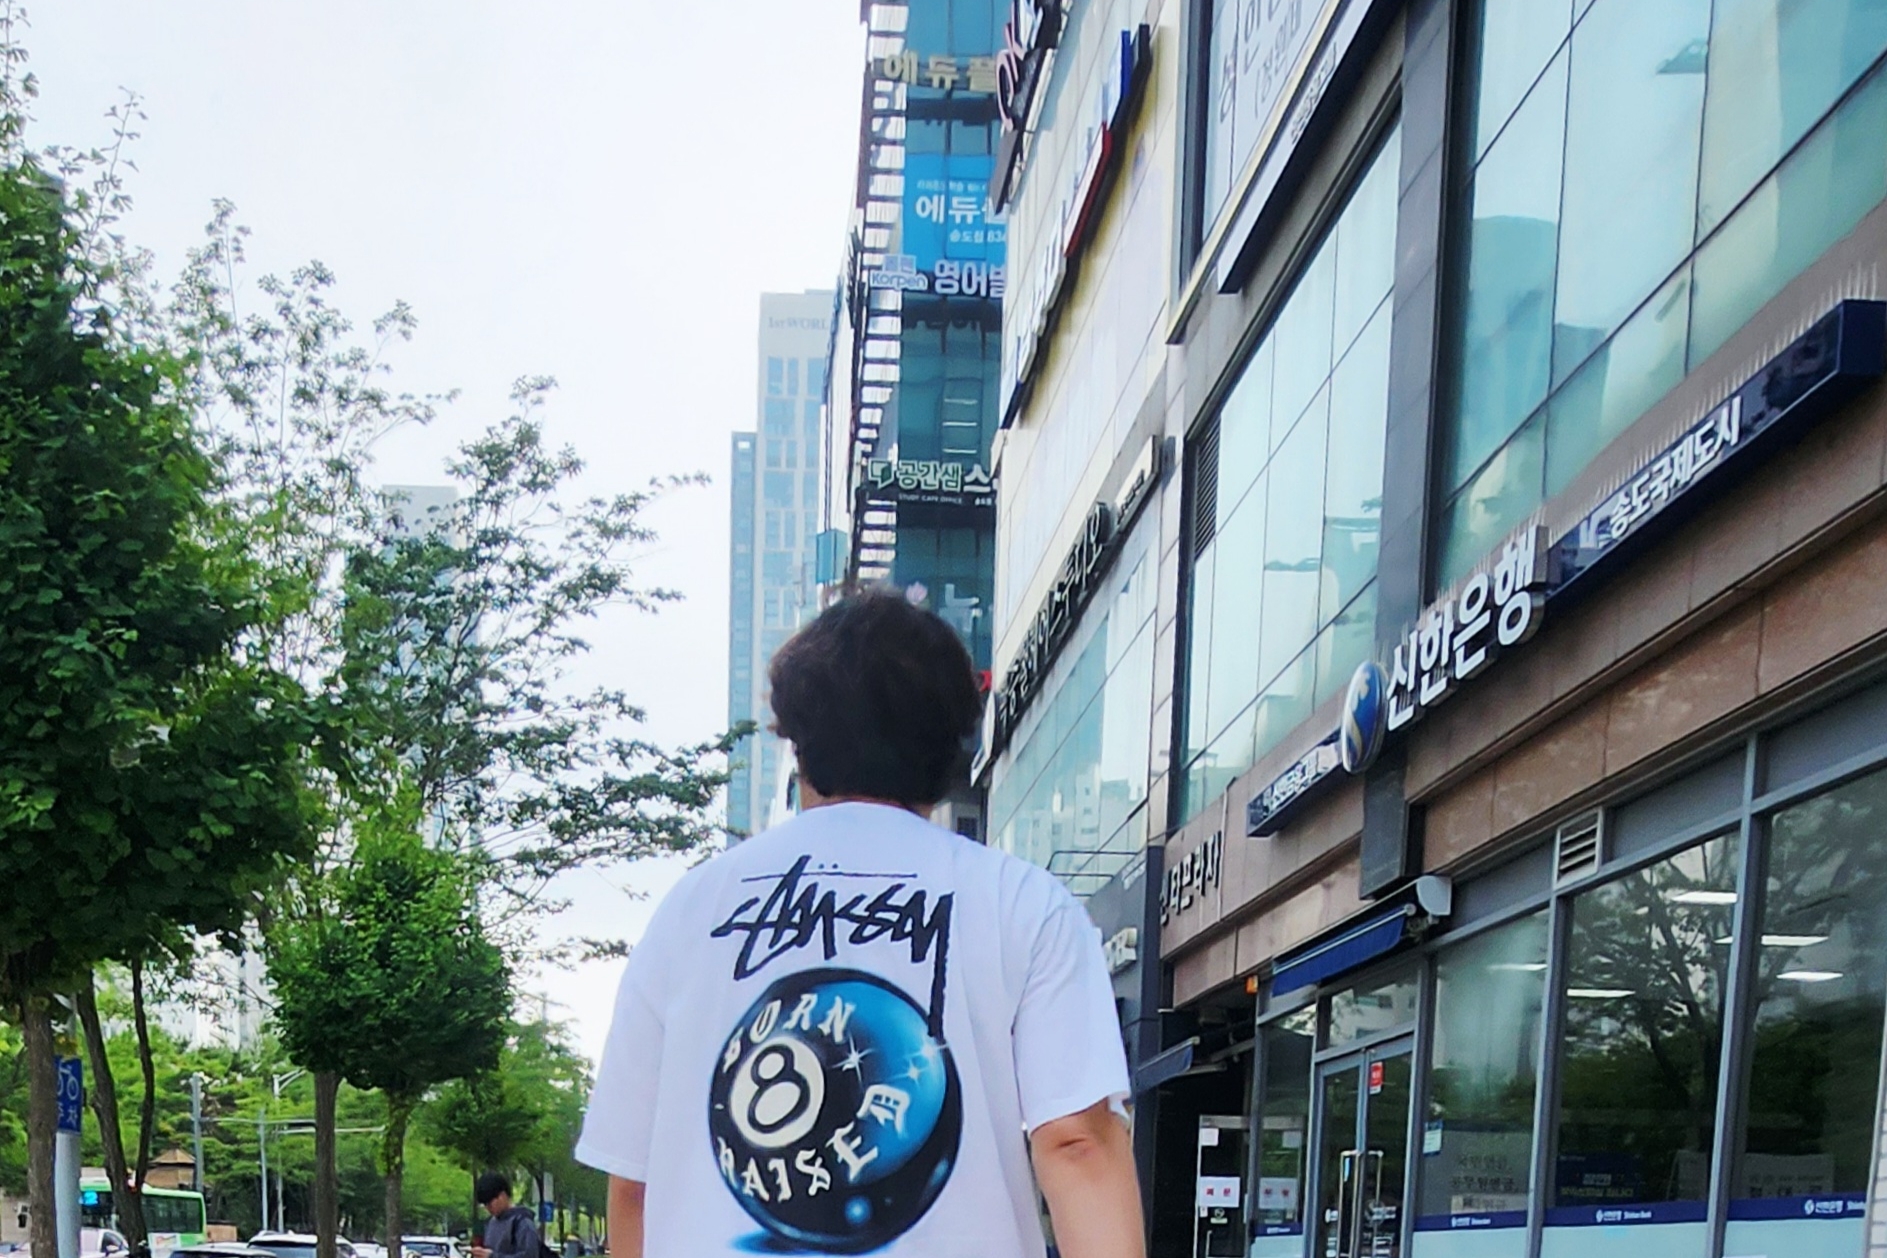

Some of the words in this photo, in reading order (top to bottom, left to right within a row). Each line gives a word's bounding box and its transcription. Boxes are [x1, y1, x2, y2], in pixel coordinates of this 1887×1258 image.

[1610, 395, 1742, 539] 송도국제도시
[1387, 525, 1538, 731] 신한은행
[722, 992, 855, 1074] BORN
[747, 1043, 811, 1134] 8
[717, 1084, 910, 1203] RAISED
